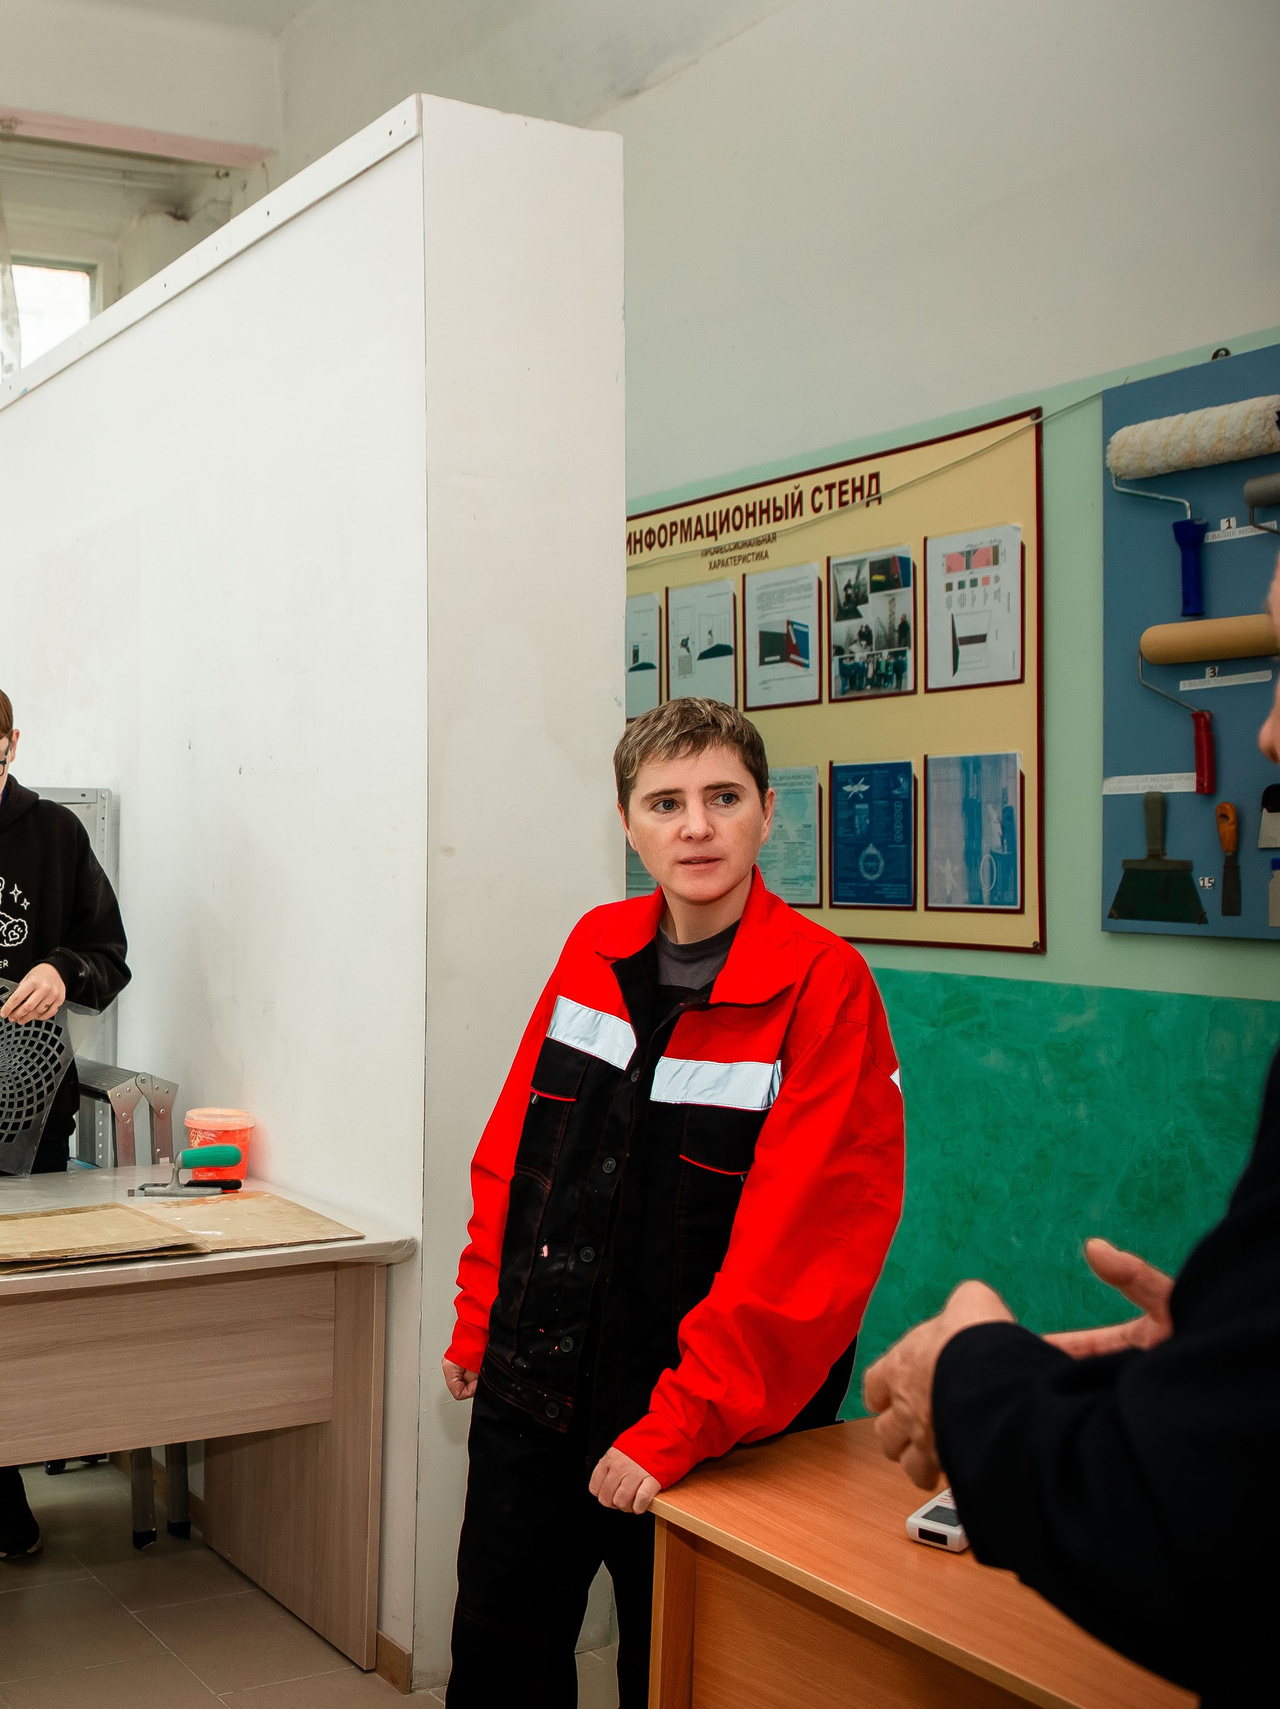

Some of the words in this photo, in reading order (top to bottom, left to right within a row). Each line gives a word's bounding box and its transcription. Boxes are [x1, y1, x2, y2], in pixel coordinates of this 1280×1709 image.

[626, 484, 804, 556] ИНФОРМАЦИОННЫЙ
[811, 471, 882, 514] СТЕНД
[1225, 518, 1232, 529] 1
[708, 549, 769, 570] ХАРАКТЕРИСТИКА
[1208, 667, 1217, 678] 3
[1200, 878, 1214, 888] 15
